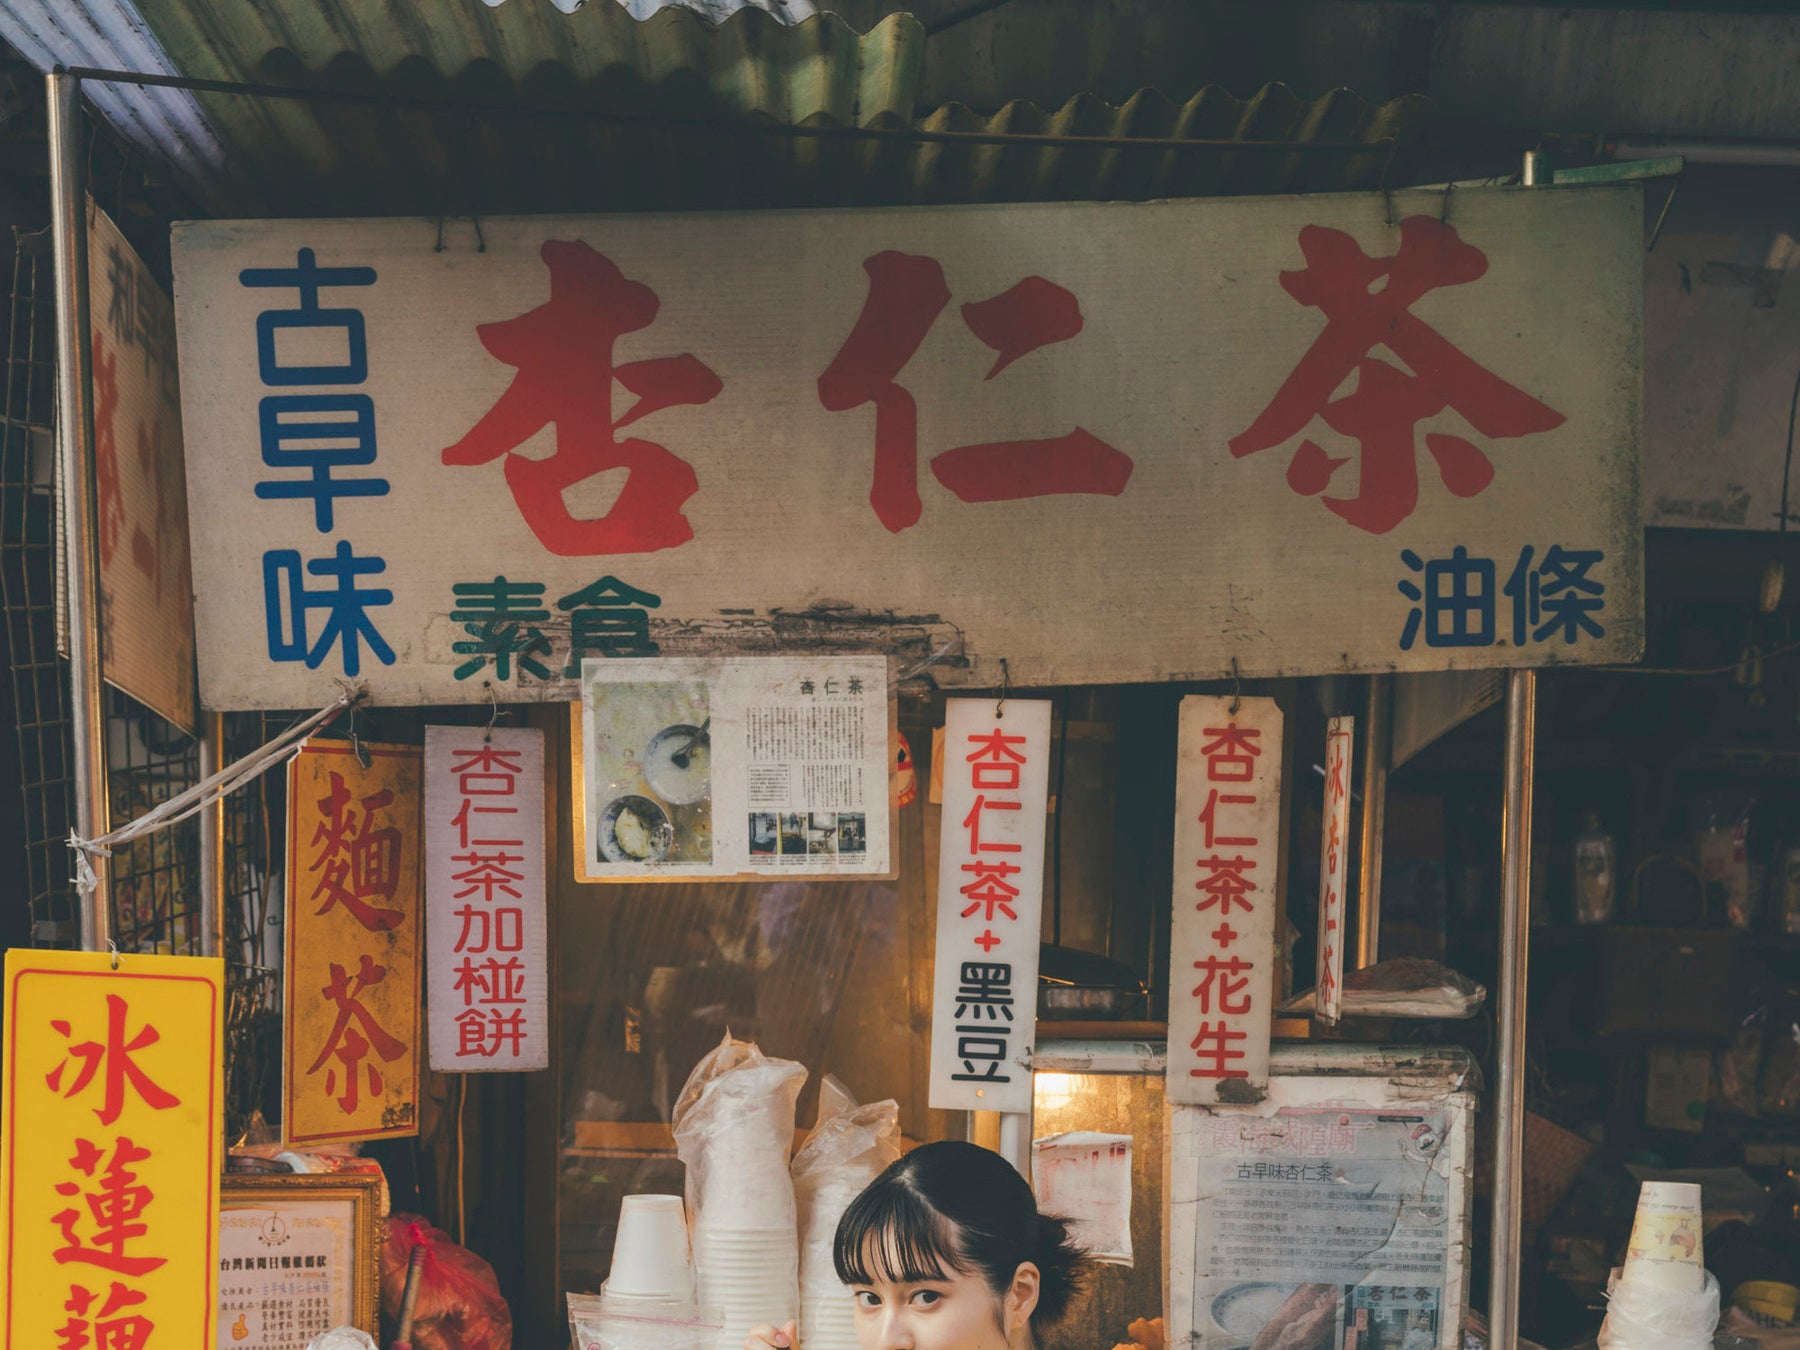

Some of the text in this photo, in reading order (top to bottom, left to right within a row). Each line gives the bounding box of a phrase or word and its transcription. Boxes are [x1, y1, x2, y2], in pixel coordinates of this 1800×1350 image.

[239, 246, 397, 676] 古早味
[441, 213, 1568, 556] 杏仁茶
[451, 574, 661, 681] 素食
[799, 678, 864, 696] 杏仁茶
[1397, 544, 1605, 651] 油條
[306, 770, 407, 1115] 麵茶
[450, 745, 527, 1058] 杏仁茶加椪餅
[951, 728, 1027, 1084] 杏仁茶+黑豆
[1189, 722, 1262, 1079] 杏仁茶+花生
[1320, 744, 1344, 1004] 冰杏仁茶
[1236, 1161, 1333, 1181] 古早味杏仁茶
